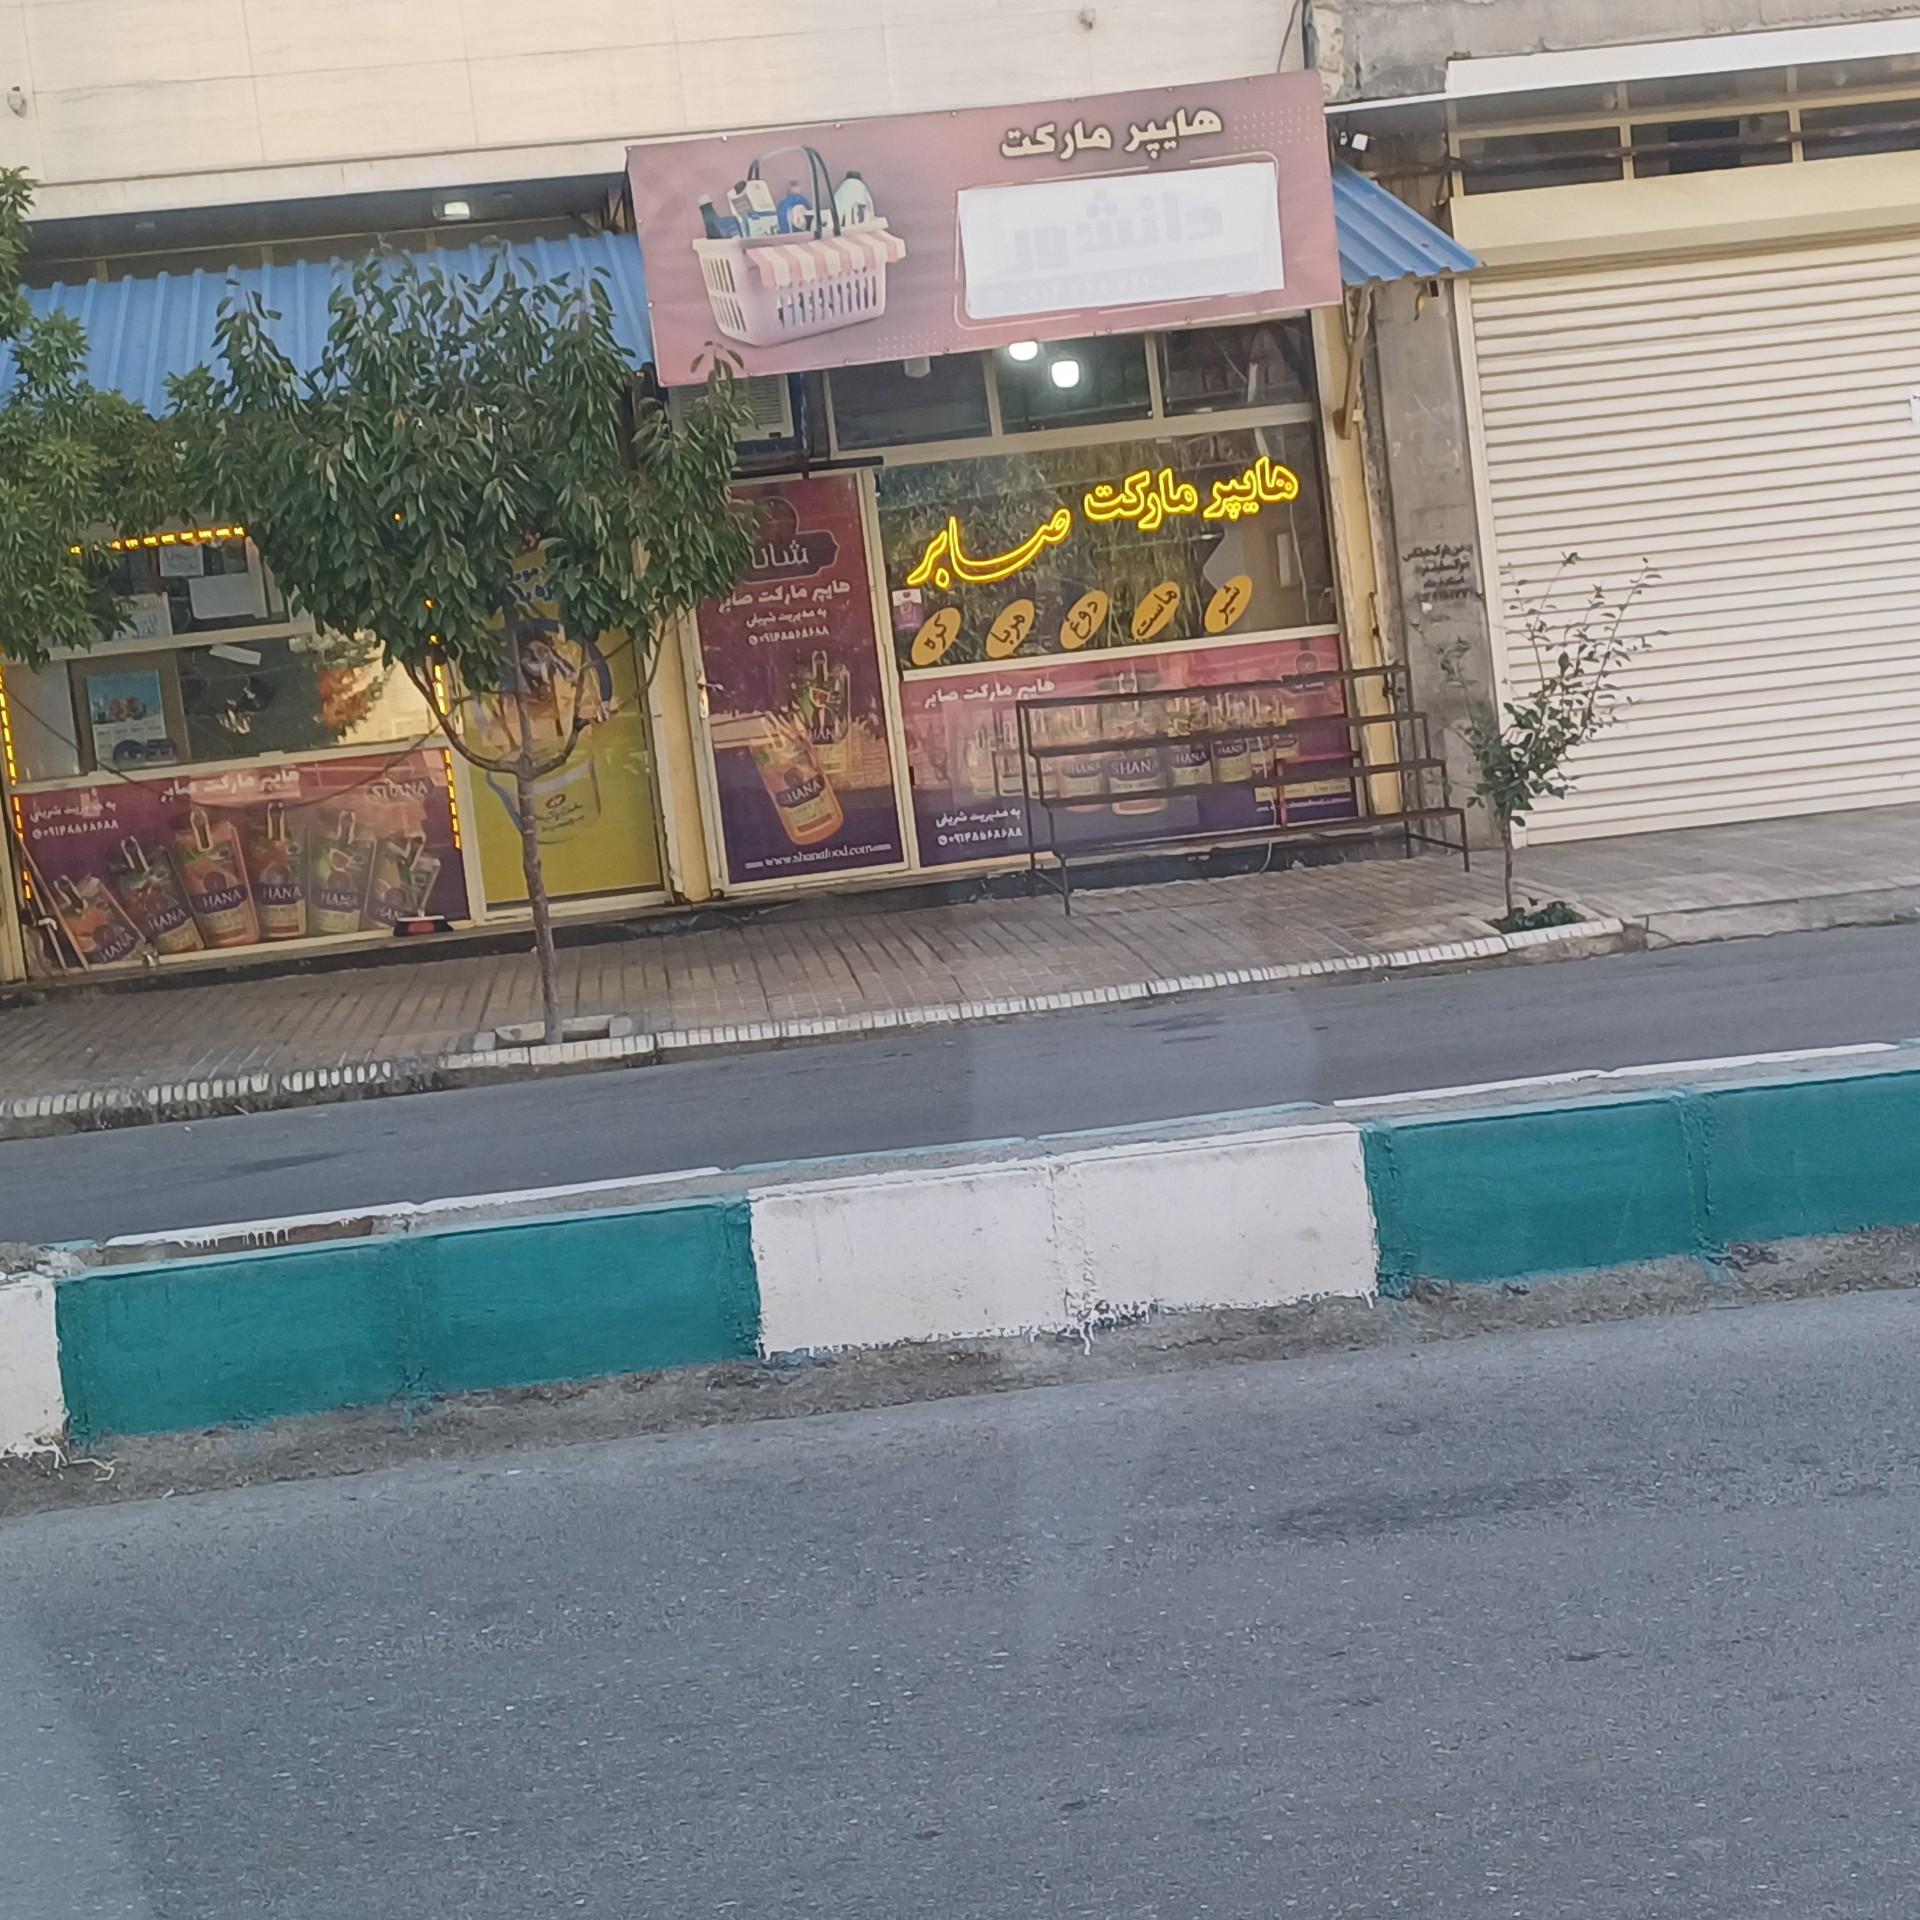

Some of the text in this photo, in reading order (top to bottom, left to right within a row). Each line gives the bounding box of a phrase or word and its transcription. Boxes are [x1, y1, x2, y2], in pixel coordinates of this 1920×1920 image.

[1000, 107, 1223, 160] هایپر مارکت
[905, 455, 1299, 589] هایپر مارکت صابر
[718, 579, 850, 614] هایپر مارکت صابر
[1136, 590, 1178, 636] ماست
[1218, 585, 1241, 625] شیر
[778, 609, 816, 626] مدیریت
[924, 613, 948, 650] کره
[990, 614, 1026, 645] مربا
[1065, 601, 1099, 640] دوغ
[925, 678, 1055, 708] هایپر مارکت صابر
[203, 773, 254, 795] مارکت
[970, 809, 1009, 824] مدیریت
[764, 844, 873, 867] www.shanafood.com
